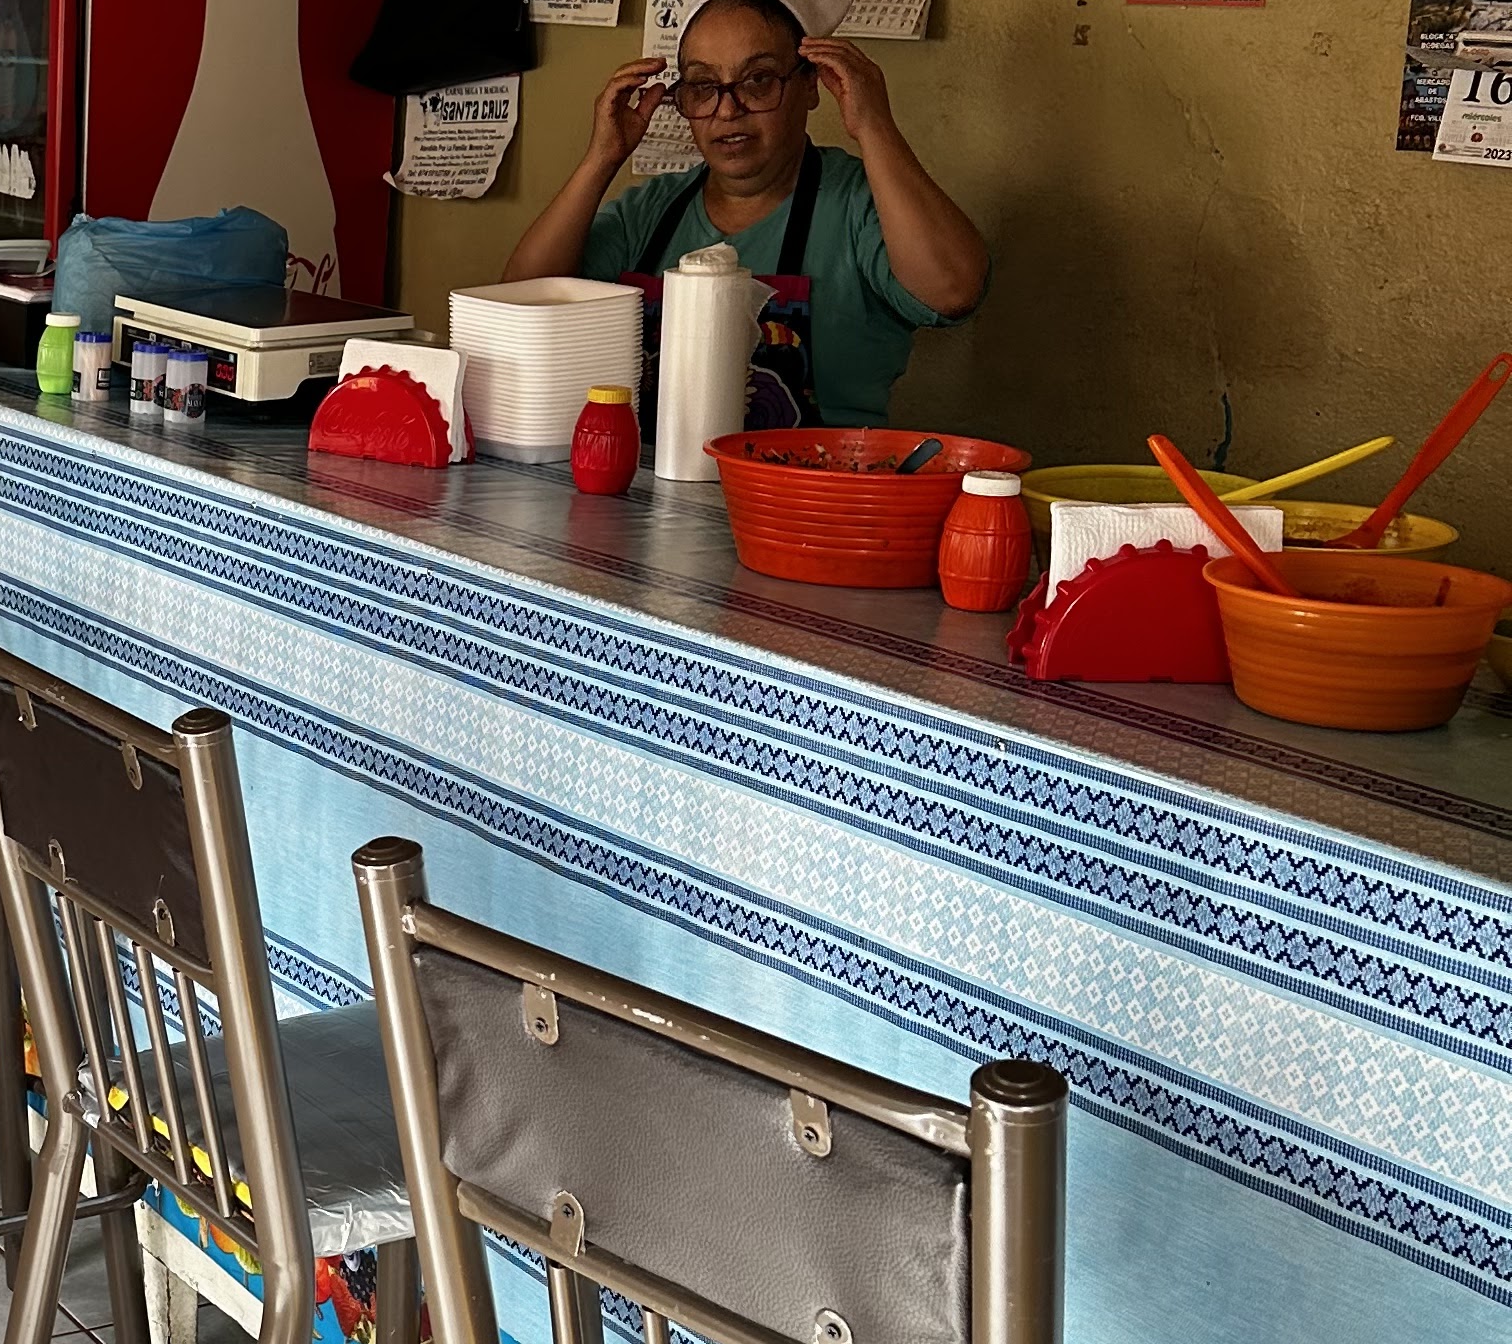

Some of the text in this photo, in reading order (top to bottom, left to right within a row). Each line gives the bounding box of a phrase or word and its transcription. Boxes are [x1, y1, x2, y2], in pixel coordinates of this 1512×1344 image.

[1462, 71, 1512, 105] 16
[481, 99, 510, 120] CRUZ
[1483, 148, 1512, 161] 2023
